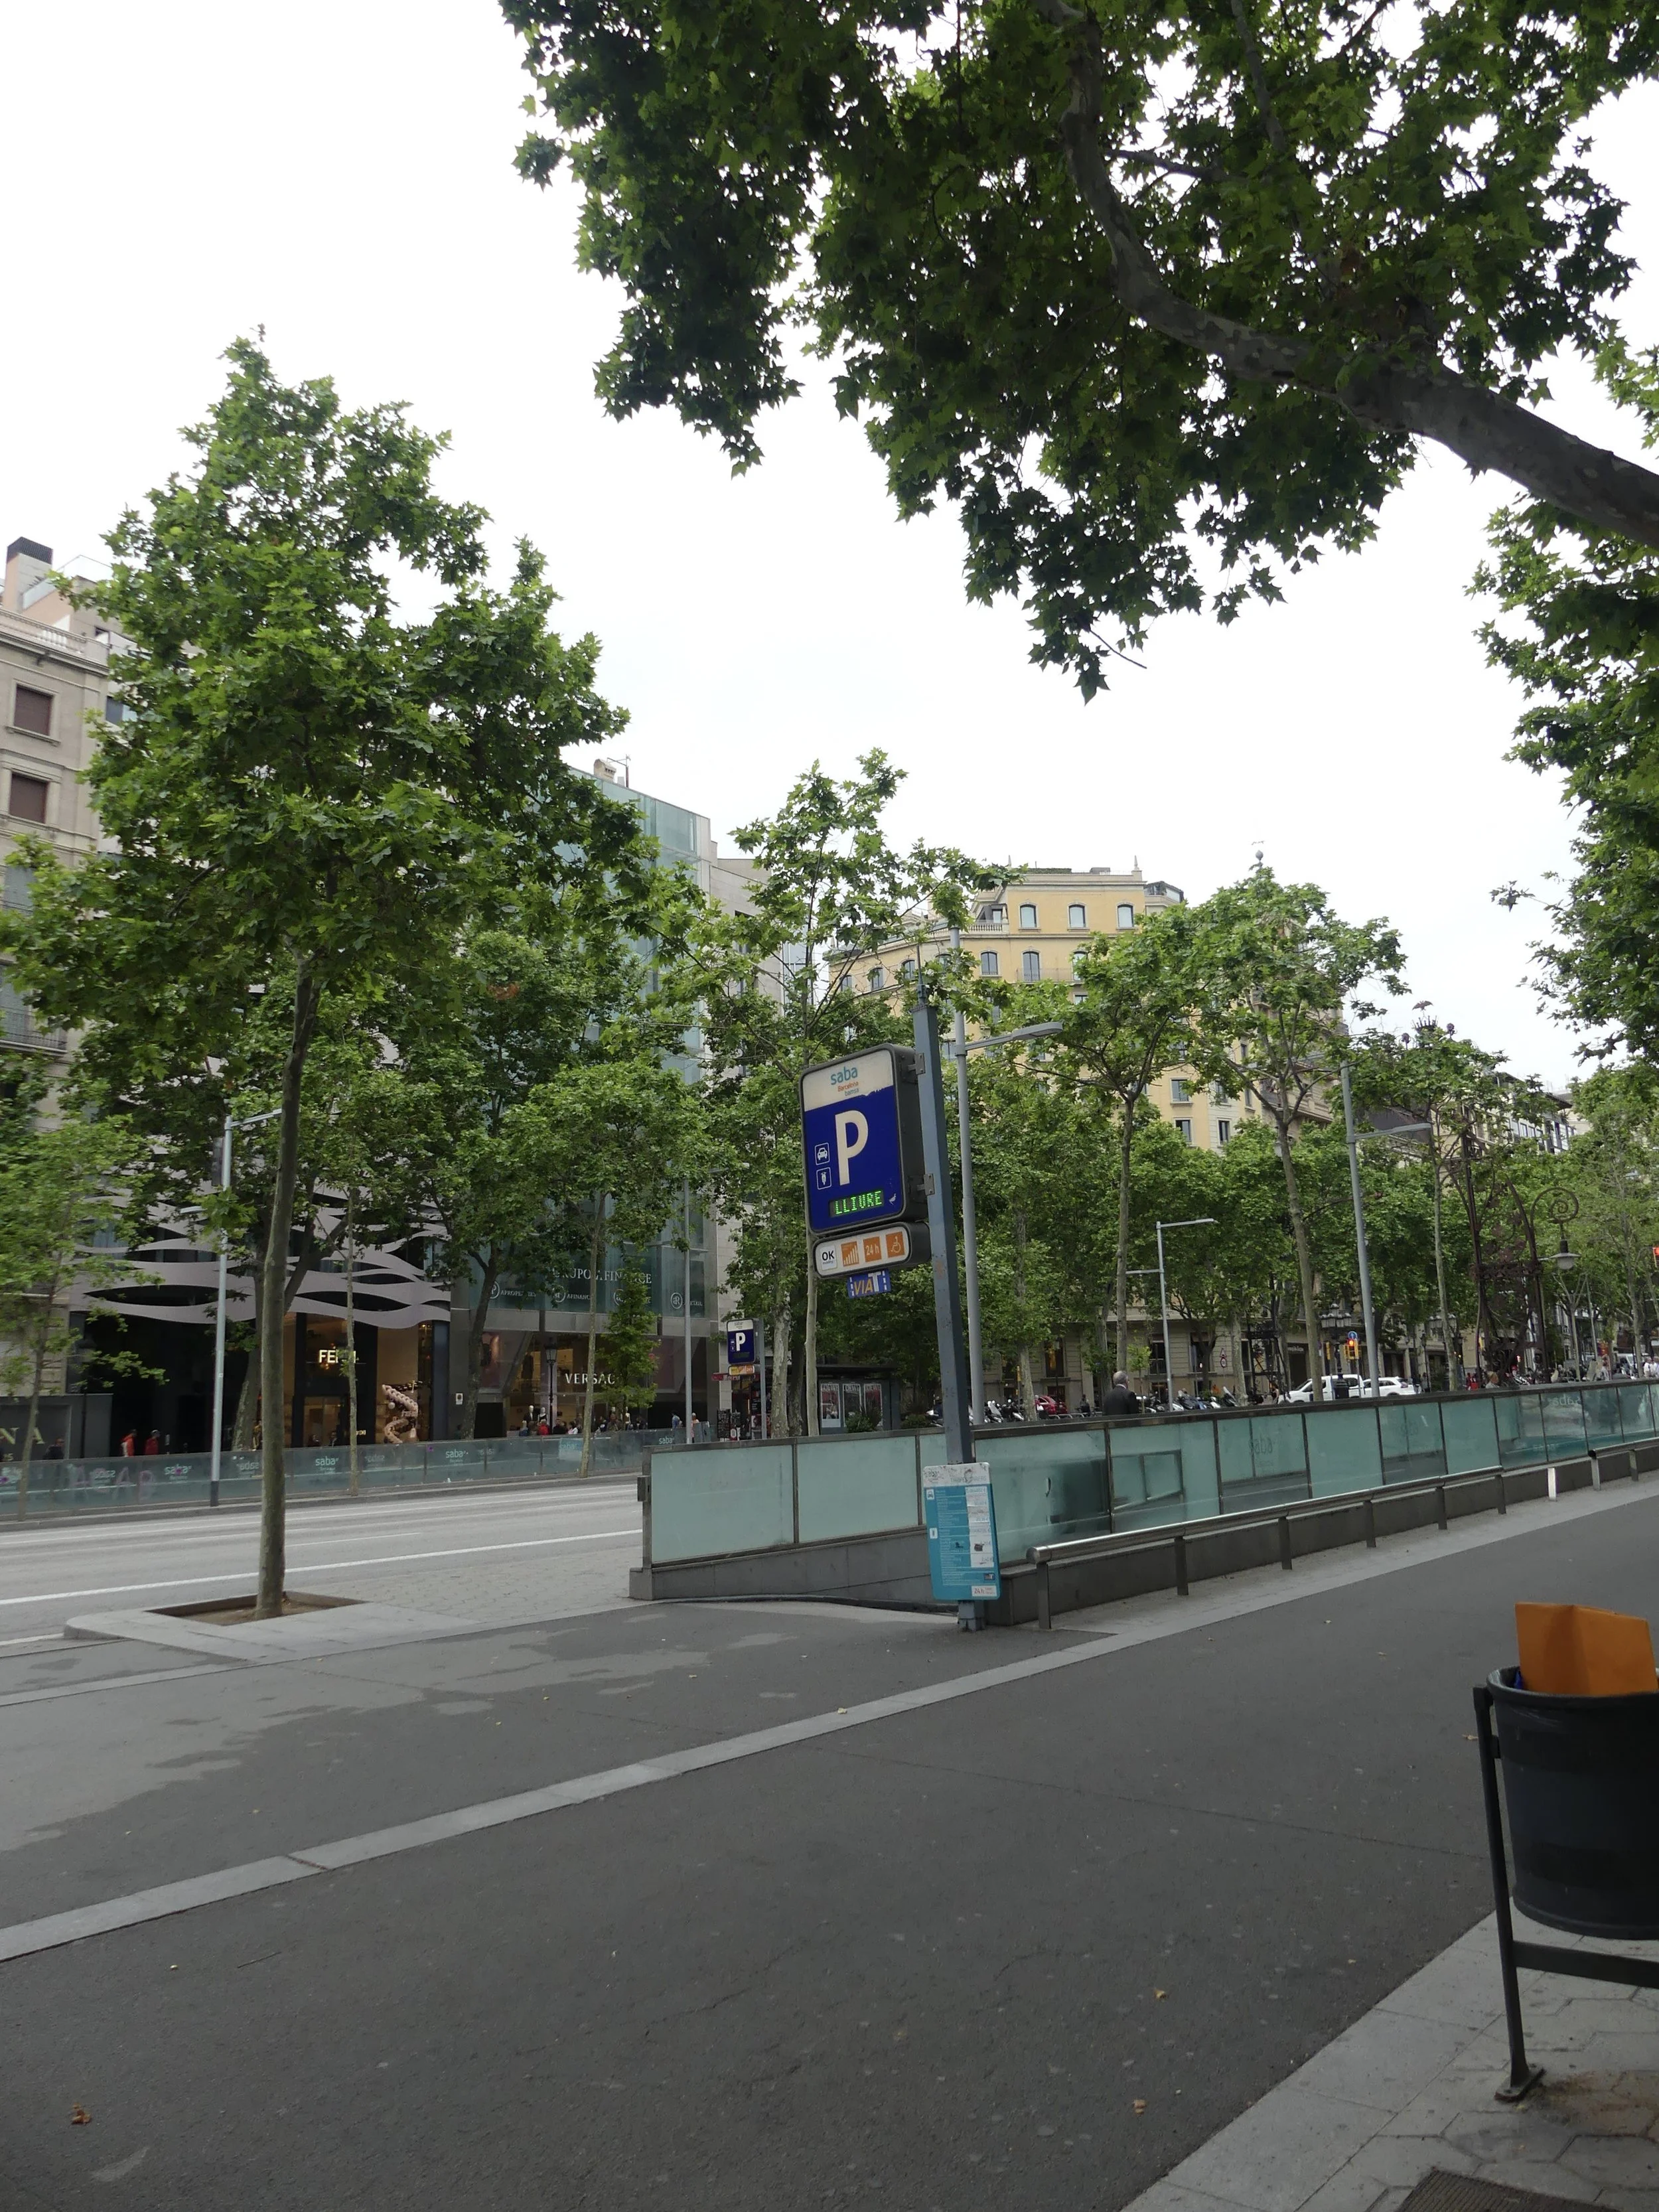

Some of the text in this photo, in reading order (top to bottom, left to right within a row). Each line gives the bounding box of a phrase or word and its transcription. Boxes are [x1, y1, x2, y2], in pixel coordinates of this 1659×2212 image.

[830, 1066, 858, 1085] saba
[837, 1081, 859, 1092] Barcelona
[834, 1110, 869, 1186] P
[834, 1191, 883, 1215] LLIURE
[865, 1244, 874, 1256] 24
[875, 1242, 880, 1254] h
[822, 1250, 835, 1262] OK
[735, 1332, 746, 1351] P
[319, 1349, 356, 1364] FEI
[565, 1373, 616, 1385] VERSAC
[658, 1436, 673, 1444] saba
[445, 1449, 464, 1458] saba
[315, 1455, 336, 1466] saba
